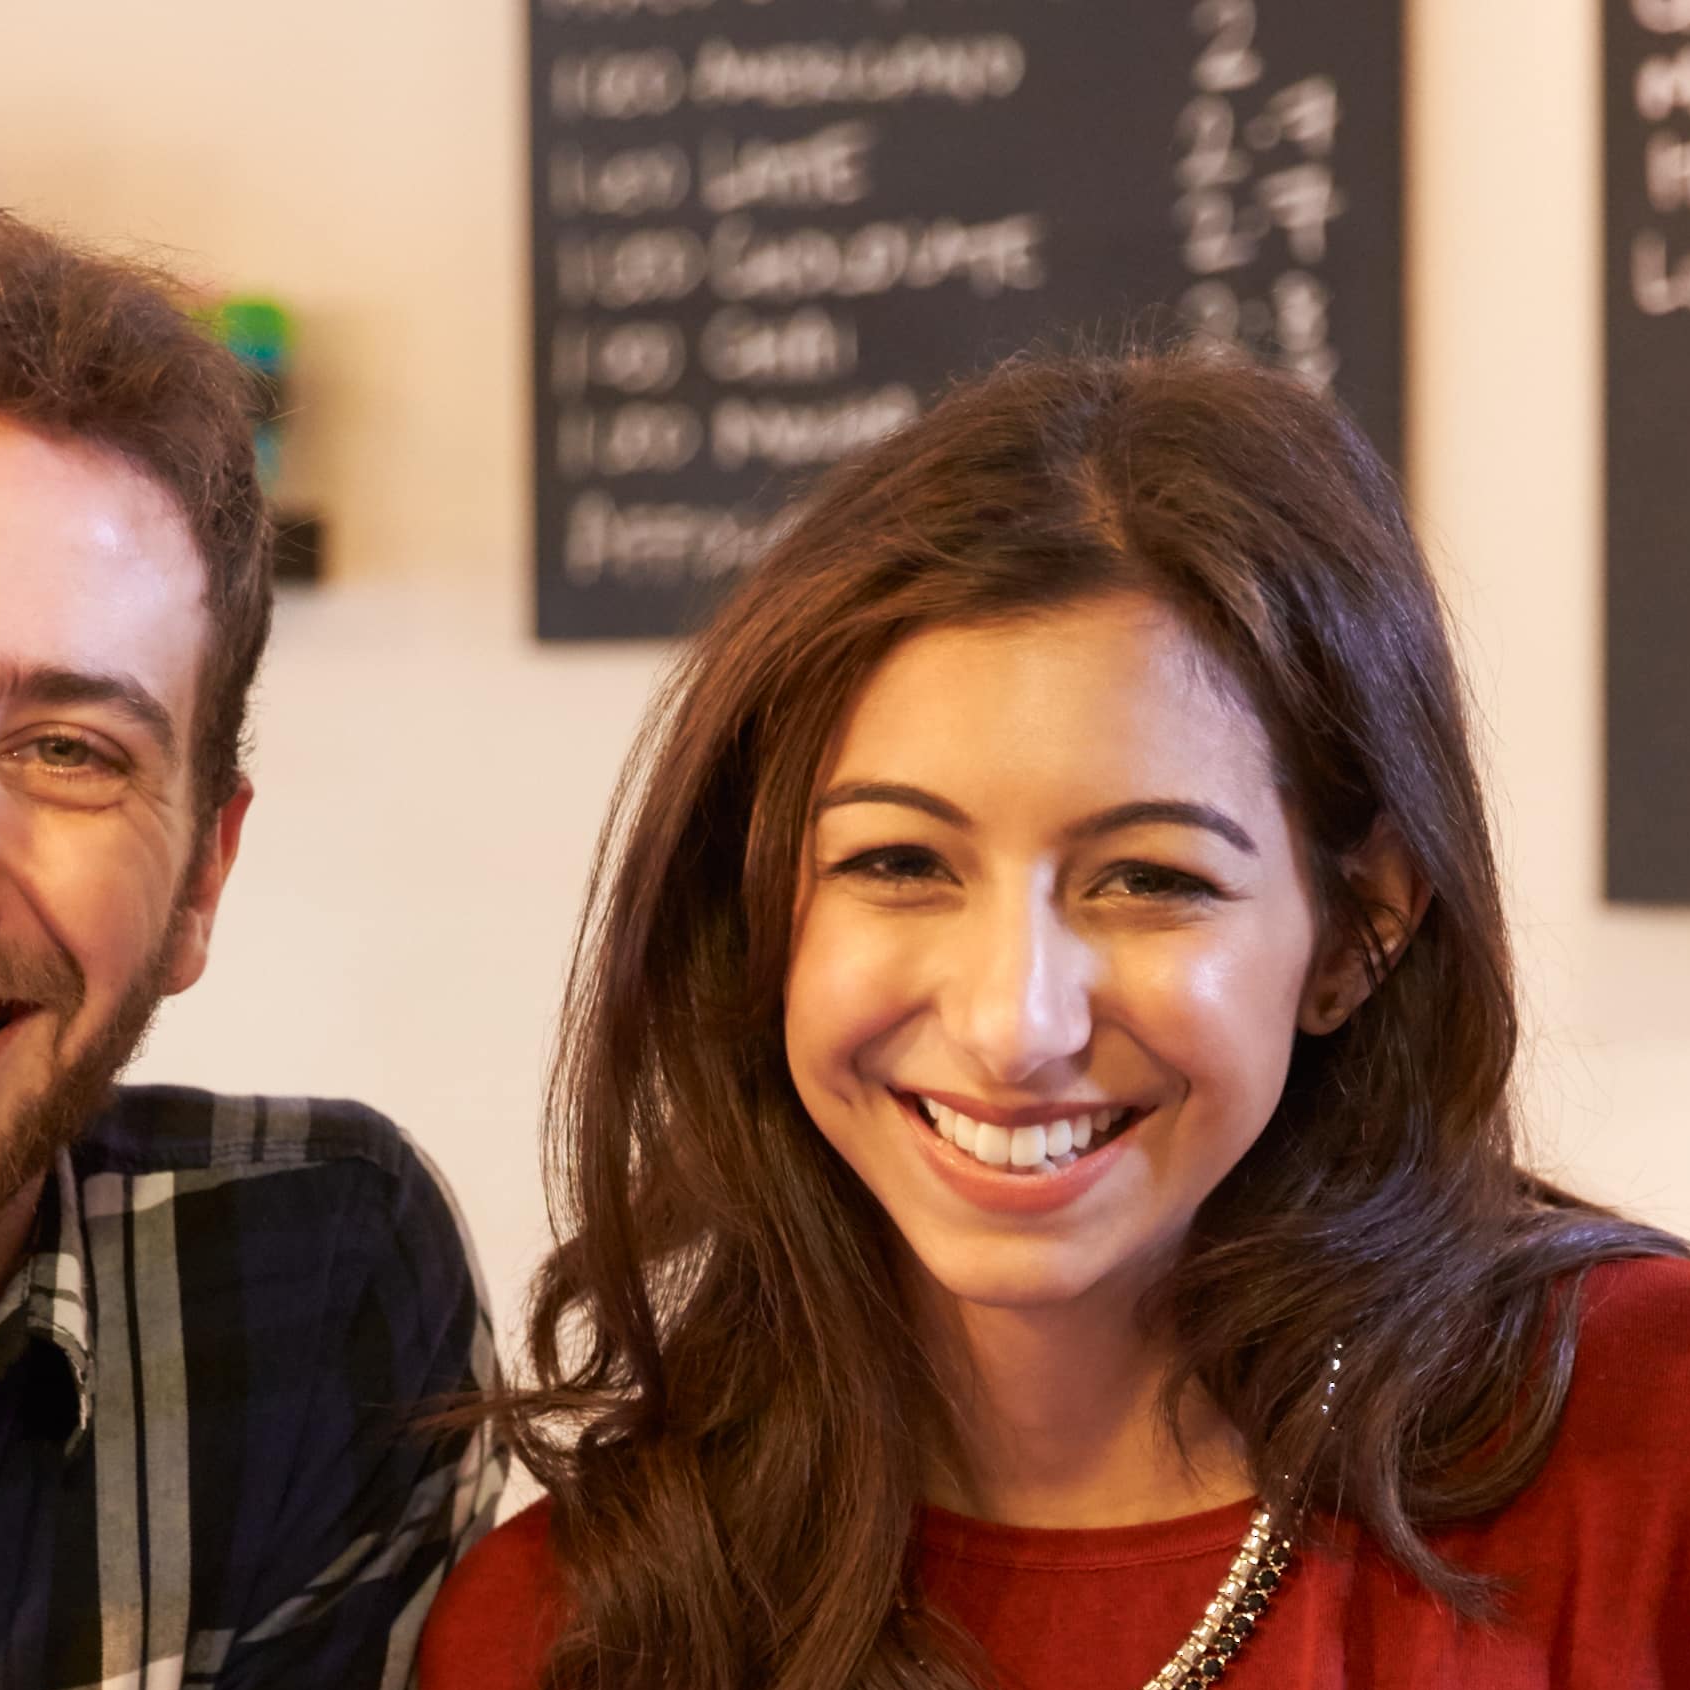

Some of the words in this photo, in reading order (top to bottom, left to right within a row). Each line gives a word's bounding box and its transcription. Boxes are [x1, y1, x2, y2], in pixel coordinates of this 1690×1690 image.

[700, 120, 879, 212] LATTE
[713, 212, 1048, 302] CHOCOLATE
[700, 305, 858, 383] CHAI
